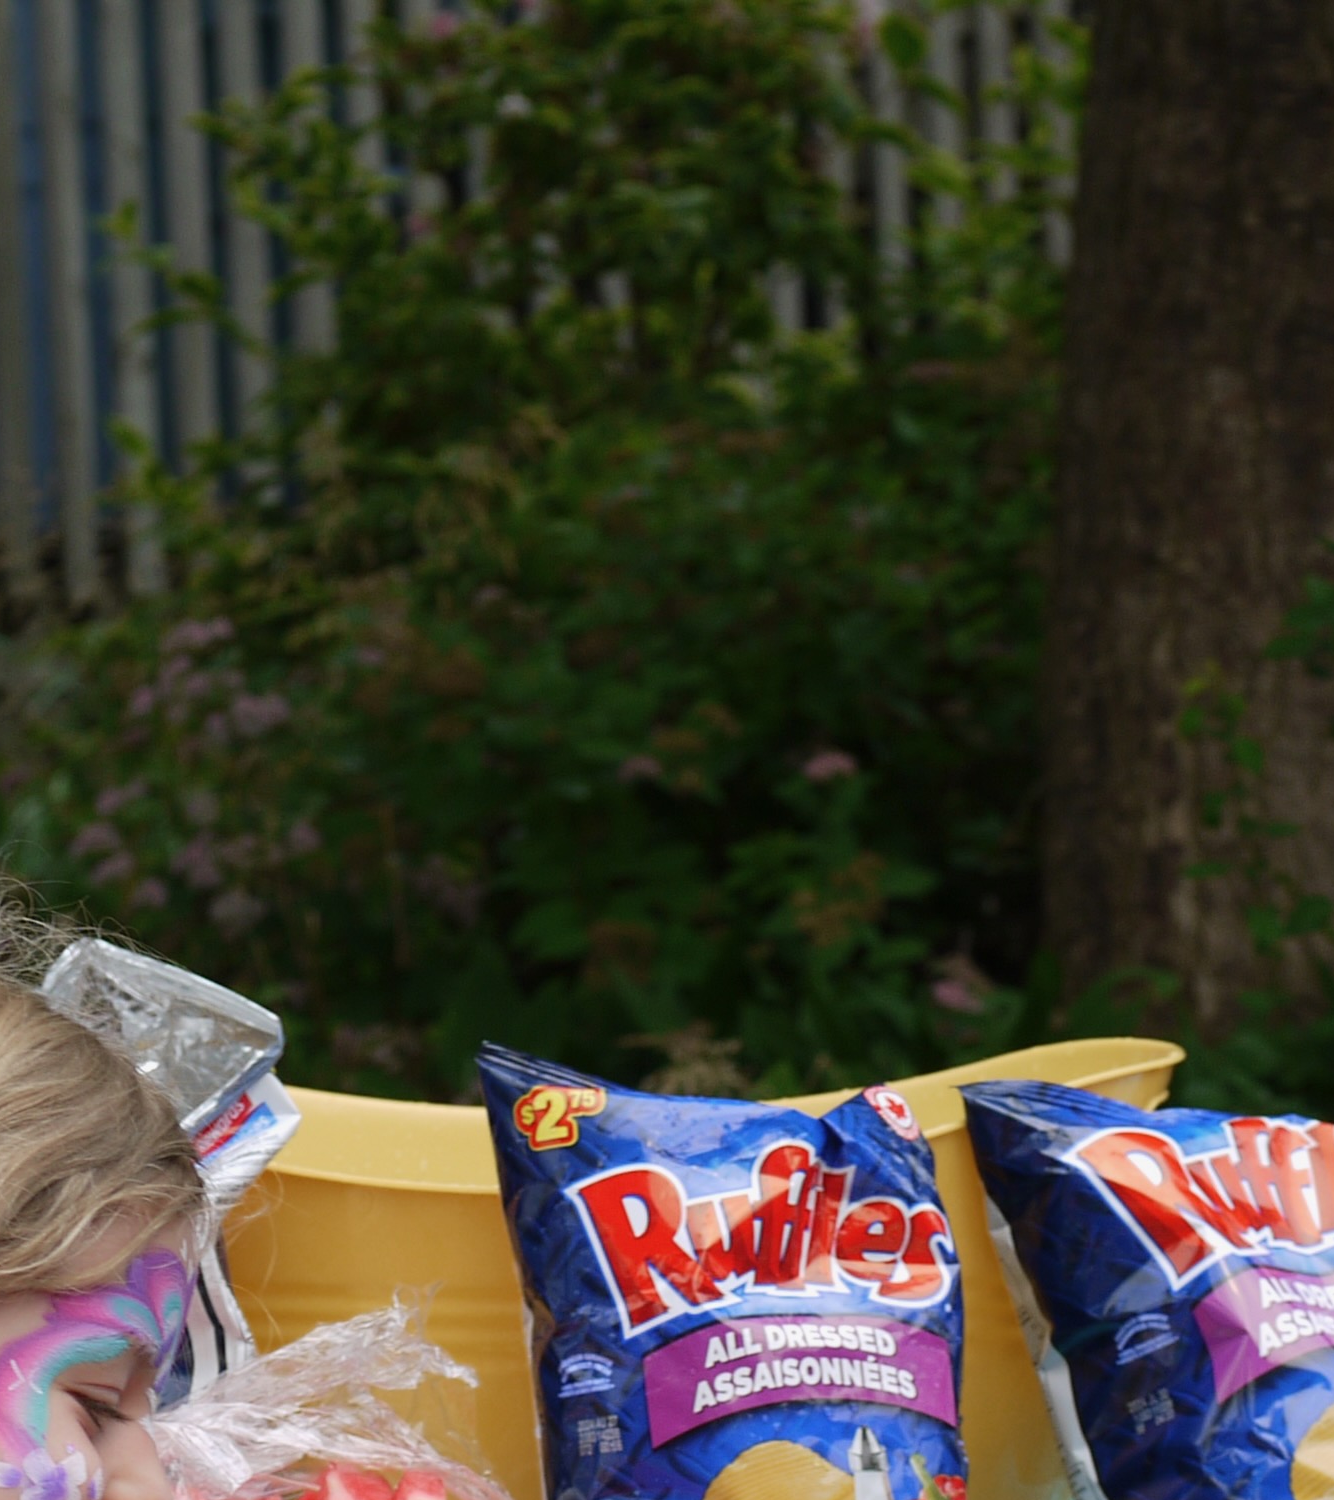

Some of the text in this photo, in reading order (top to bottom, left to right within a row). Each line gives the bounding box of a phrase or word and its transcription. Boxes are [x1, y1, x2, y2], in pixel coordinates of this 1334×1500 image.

[566, 1139, 959, 1339] Ruffles
[1259, 1276, 1303, 1312] ALL
[704, 1324, 897, 1369] ALL DRESSED
[692, 1354, 918, 1415] ASSAISONNÉES
